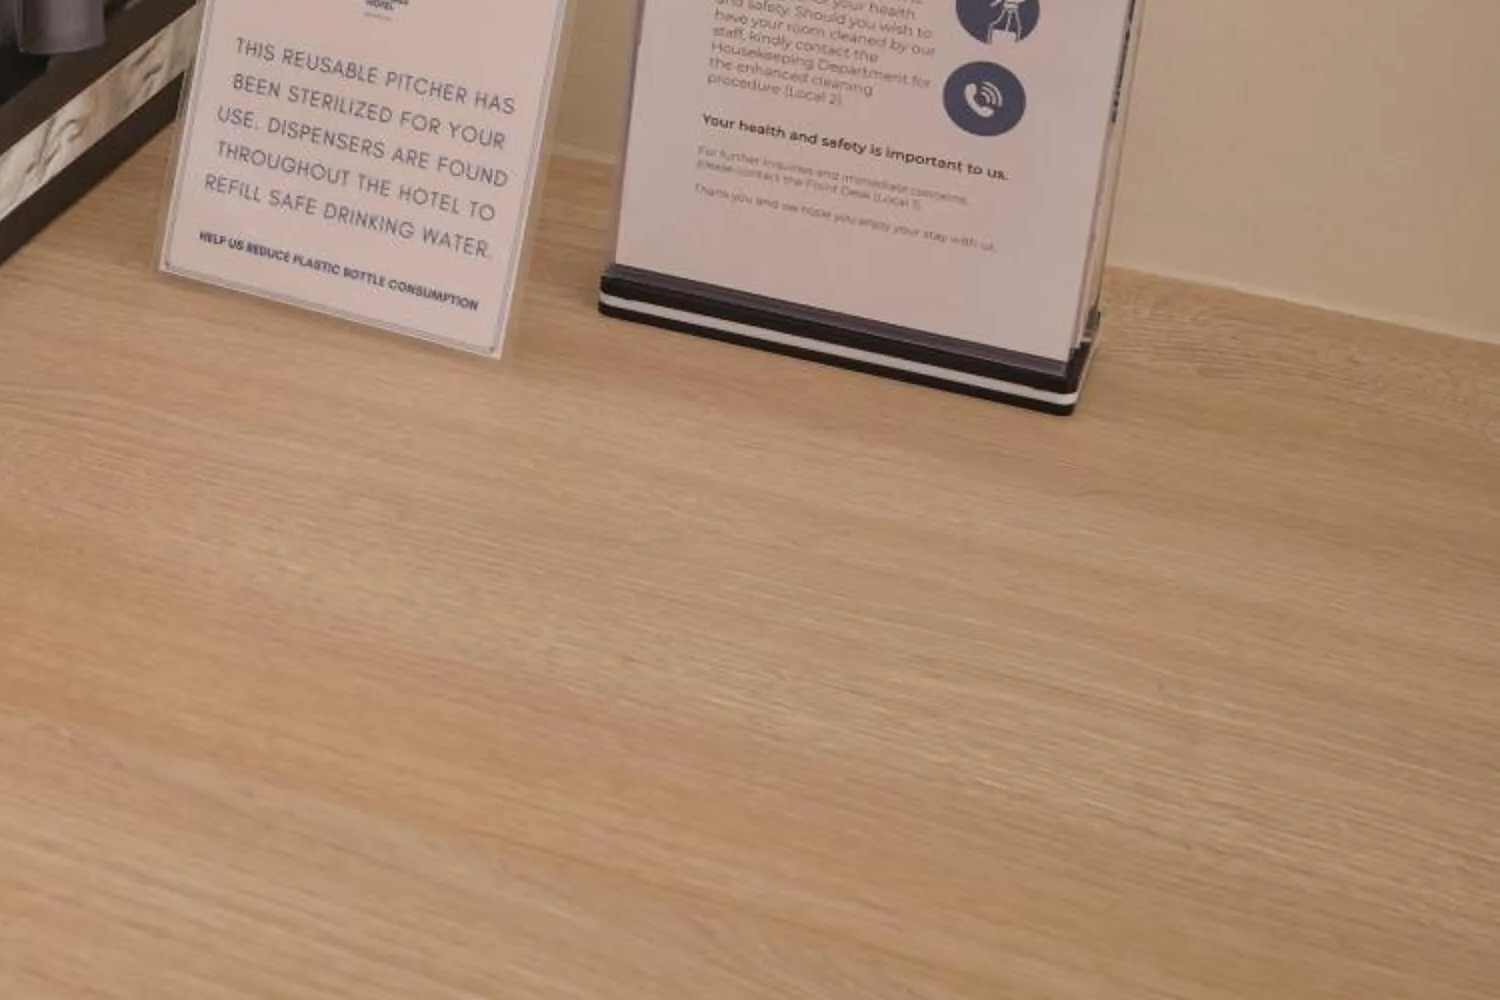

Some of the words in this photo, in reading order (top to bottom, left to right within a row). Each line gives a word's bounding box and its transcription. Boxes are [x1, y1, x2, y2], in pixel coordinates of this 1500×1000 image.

[714, 8, 748, 25] have
[749, 17, 783, 30] your
[786, 23, 825, 38] room
[828, 28, 887, 48] cleaned
[888, 37, 907, 54] by
[910, 43, 936, 56] our
[794, 5, 847, 25] Should
[847, 16, 876, 30] you
[878, 21, 913, 36] wish
[916, 27, 932, 39] to
[868, 1, 915, 20] health
[710, 41, 814, 71] Housekeeping
[817, 58, 907, 85] Department
[911, 74, 931, 88] for
[748, 29, 792, 51] kindly
[794, 40, 850, 59] contact
[852, 48, 879, 63] the
[236, 36, 275, 62] THIS
[281, 47, 378, 84] REUSABLE
[384, 70, 468, 104] PITCHER
[474, 91, 515, 115] HAS
[706, 73, 781, 95] procedure
[708, 56, 733, 71] the
[735, 62, 808, 84] enhanced
[810, 76, 873, 98] cleaning
[232, 72, 280, 97] BEEN
[286, 84, 392, 123] STERILIZED
[399, 110, 441, 135] FOR
[449, 121, 505, 150] YOUR
[216, 105, 258, 130] USE.
[266, 116, 384, 158] DISPENSERS
[390, 146, 430, 169] ARE
[436, 155, 508, 187] FOUND
[702, 113, 735, 129] Your
[738, 119, 786, 138] health
[788, 130, 818, 145] and
[821, 137, 867, 155] safety
[869, 143, 882, 157] is
[885, 147, 962, 172] important
[966, 163, 983, 175] to
[986, 168, 1008, 180] us.
[203, 172, 260, 203] REFILL
[268, 189, 317, 215] SAFE
[322, 201, 414, 239] DRINKING
[218, 139, 350, 185] THROUGHOUT
[357, 172, 391, 197] THE
[397, 183, 459, 214] HOTEL
[469, 199, 495, 221] TO
[198, 231, 226, 245] HELP
[227, 237, 244, 251] US
[245, 241, 290, 263] REDUCE
[292, 253, 340, 275] PLASTIC
[342, 266, 385, 287] BOTTLE
[387, 278, 478, 310] CONSUMPTION
